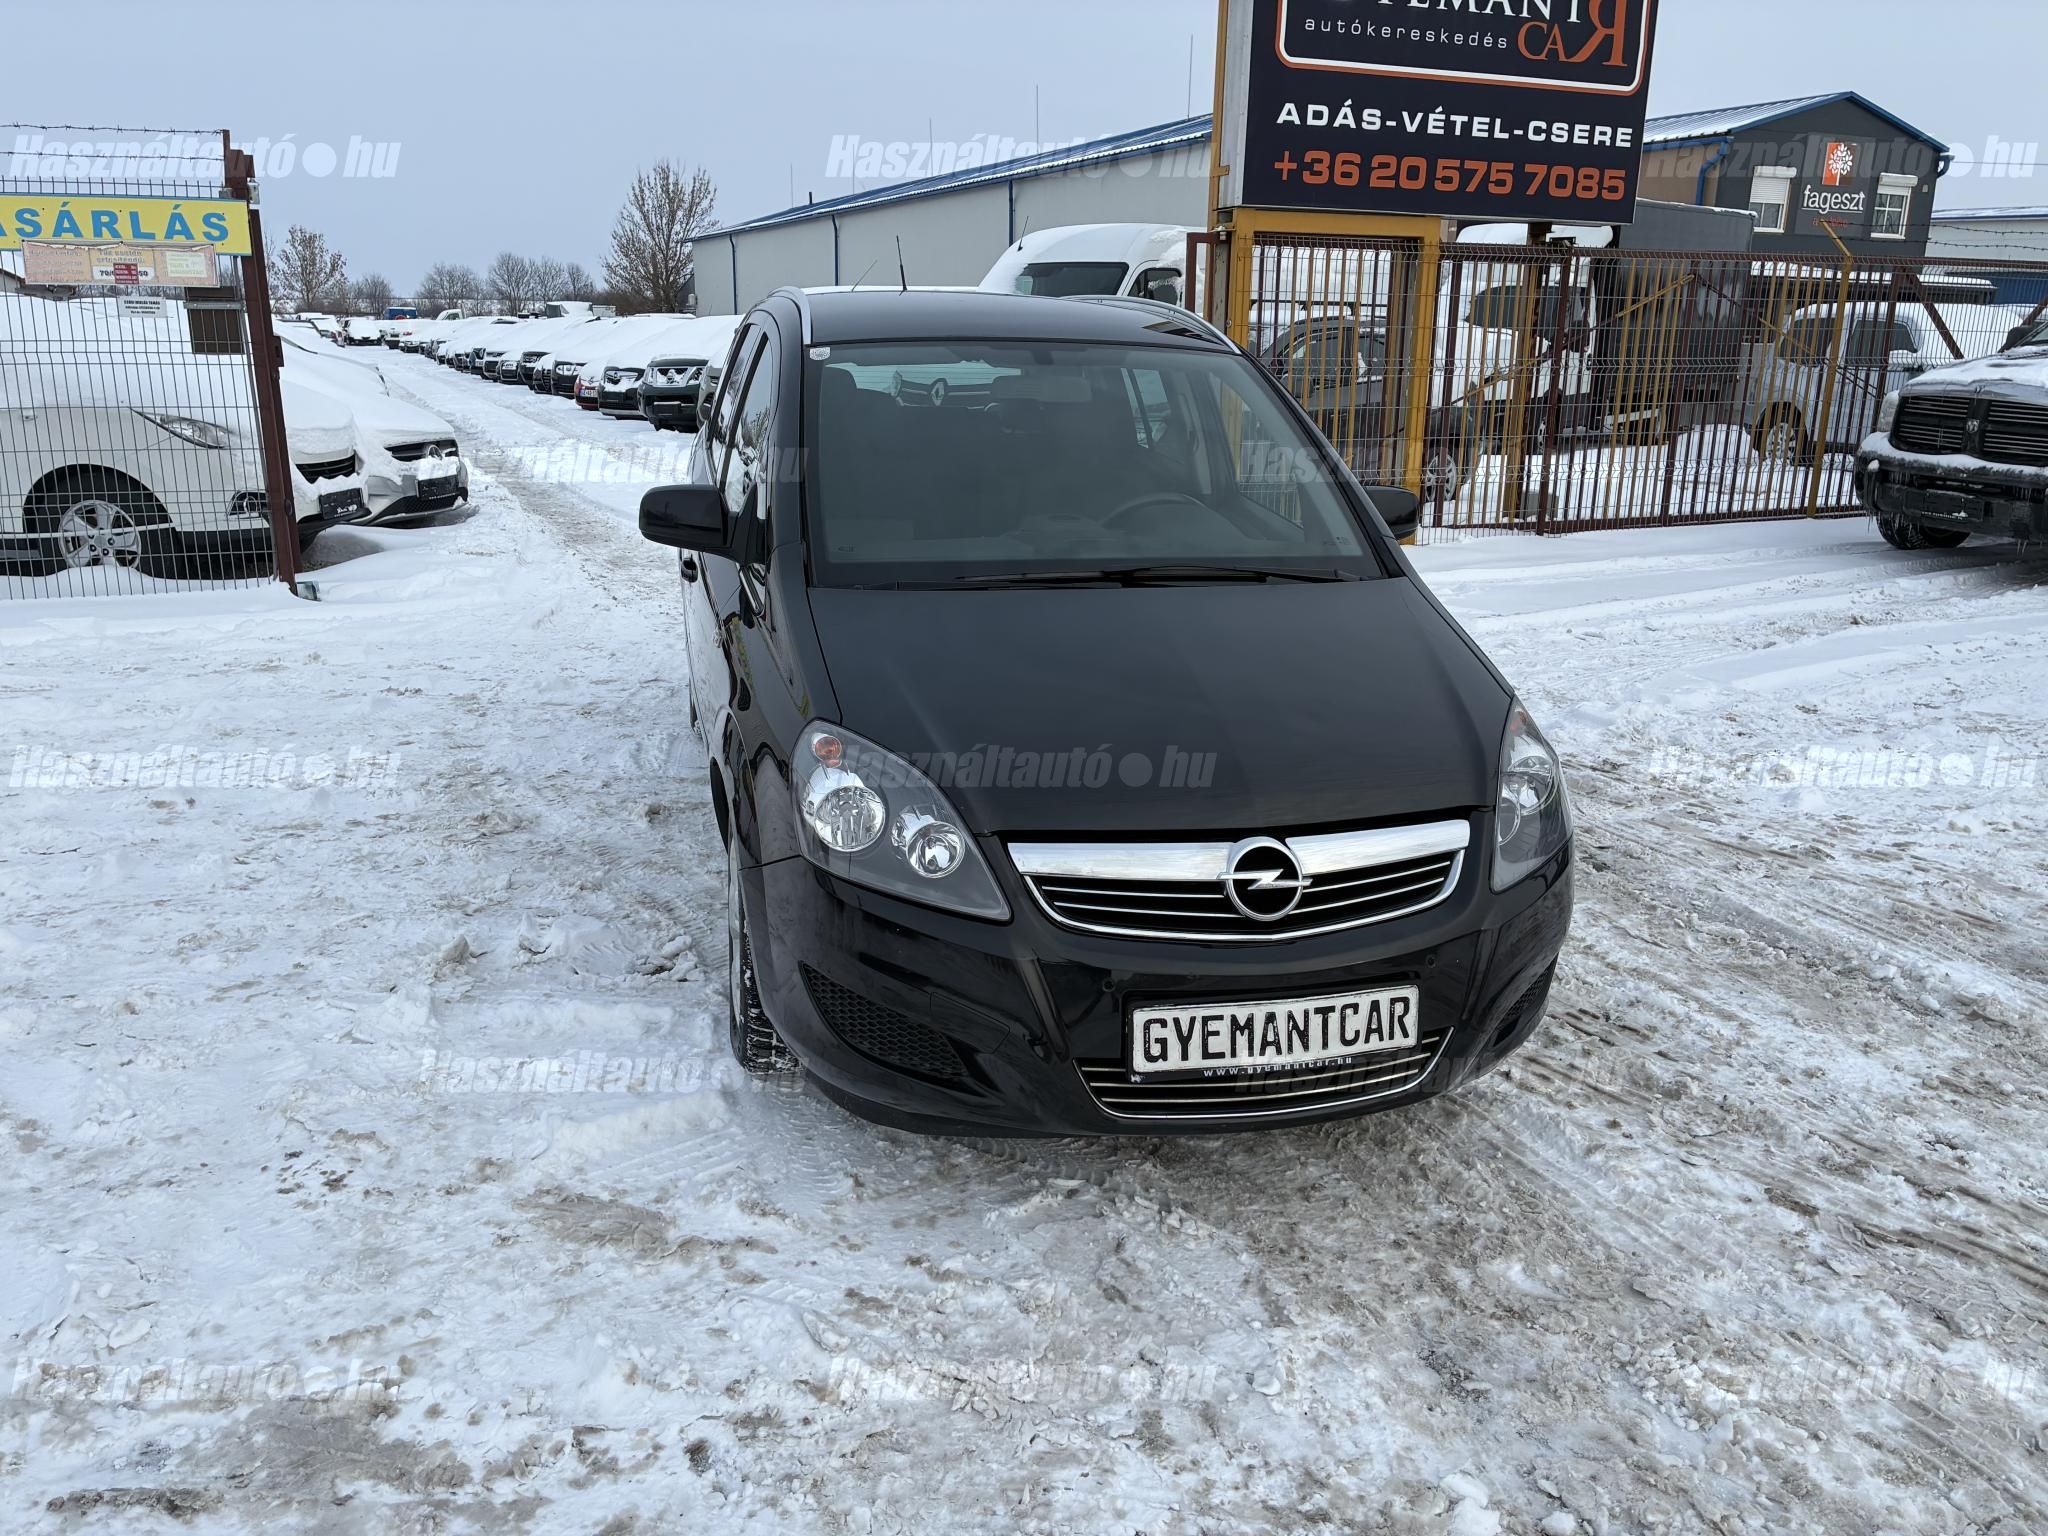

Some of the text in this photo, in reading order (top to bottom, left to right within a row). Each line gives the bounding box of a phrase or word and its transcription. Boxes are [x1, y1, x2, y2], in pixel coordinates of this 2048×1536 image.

[1304, 18, 1508, 50] autókereskedés
[1276, 98, 1633, 148] ADÁS-VÉTEL-CSERE
[1274, 150, 1627, 200] +36 20 575 7085
[0, 201, 229, 242] SÁRLÁS
[1803, 184, 1866, 214] fageszt
[1142, 996, 1411, 1063] GYEMANTCAR
